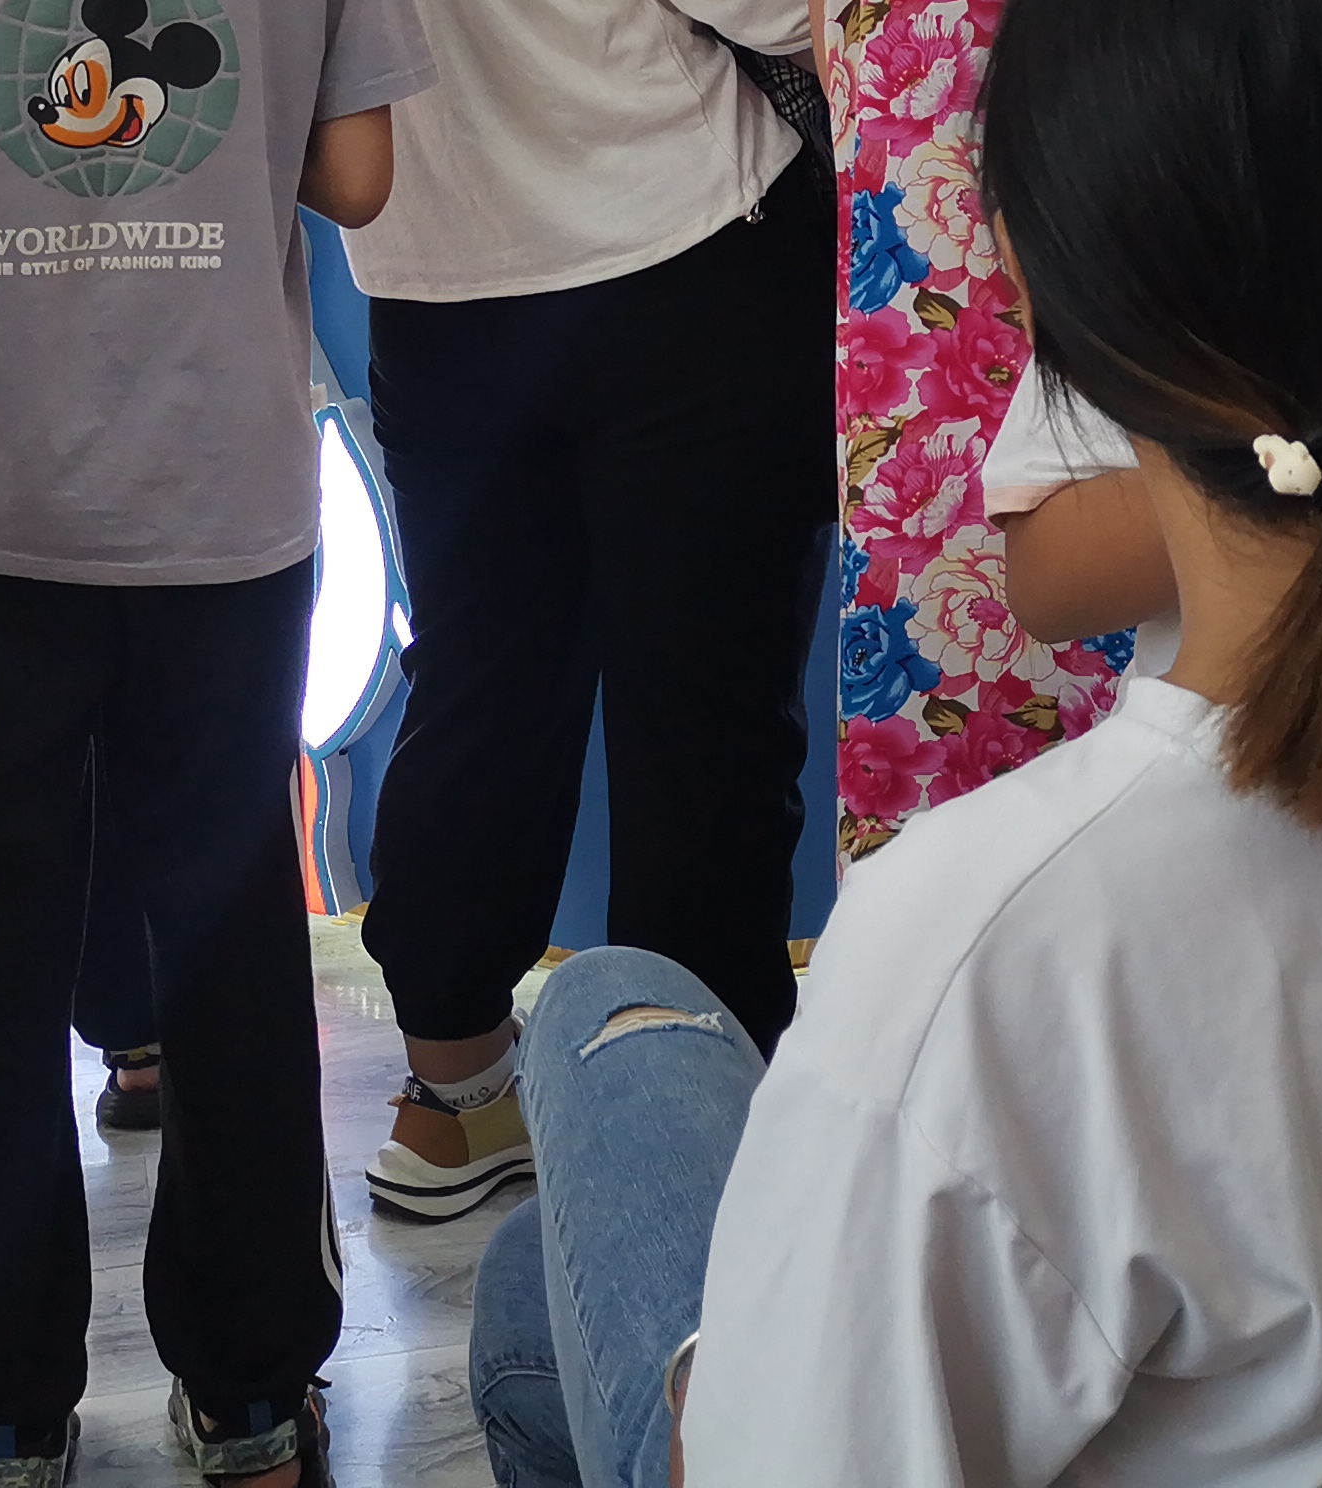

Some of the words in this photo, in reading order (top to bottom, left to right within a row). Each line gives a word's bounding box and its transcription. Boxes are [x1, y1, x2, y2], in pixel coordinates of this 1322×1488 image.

[20, 260, 69, 276] STYLE
[73, 257, 95, 271] OF
[100, 255, 174, 270] FASHION
[180, 255, 222, 269] KING
